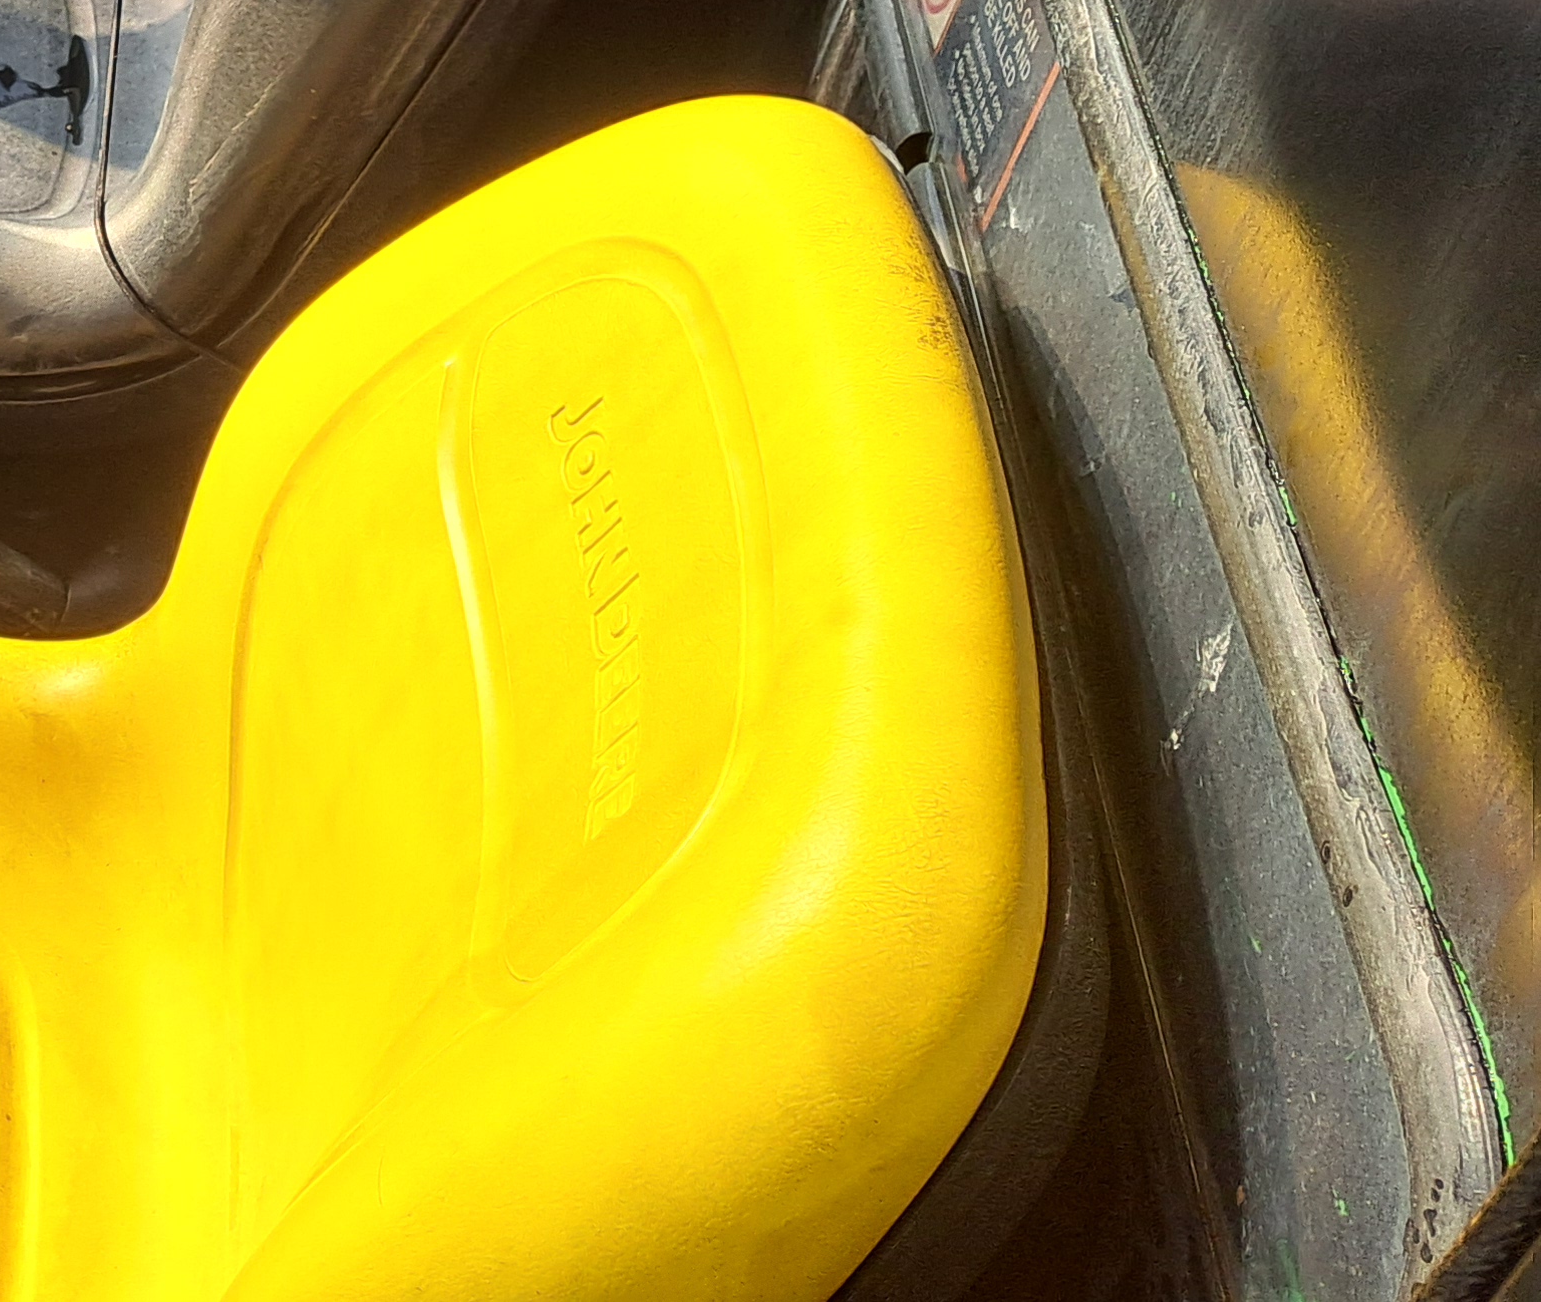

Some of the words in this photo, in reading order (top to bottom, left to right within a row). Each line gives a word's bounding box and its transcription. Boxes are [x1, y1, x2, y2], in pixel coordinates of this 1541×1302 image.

[992, 22, 1016, 88] KILLED
[1002, 1, 1019, 37] OFF
[1013, 39, 1031, 82] AND
[1021, 7, 1040, 53] CAN
[548, 395, 629, 599] JOHN
[582, 572, 640, 845] DEERE
